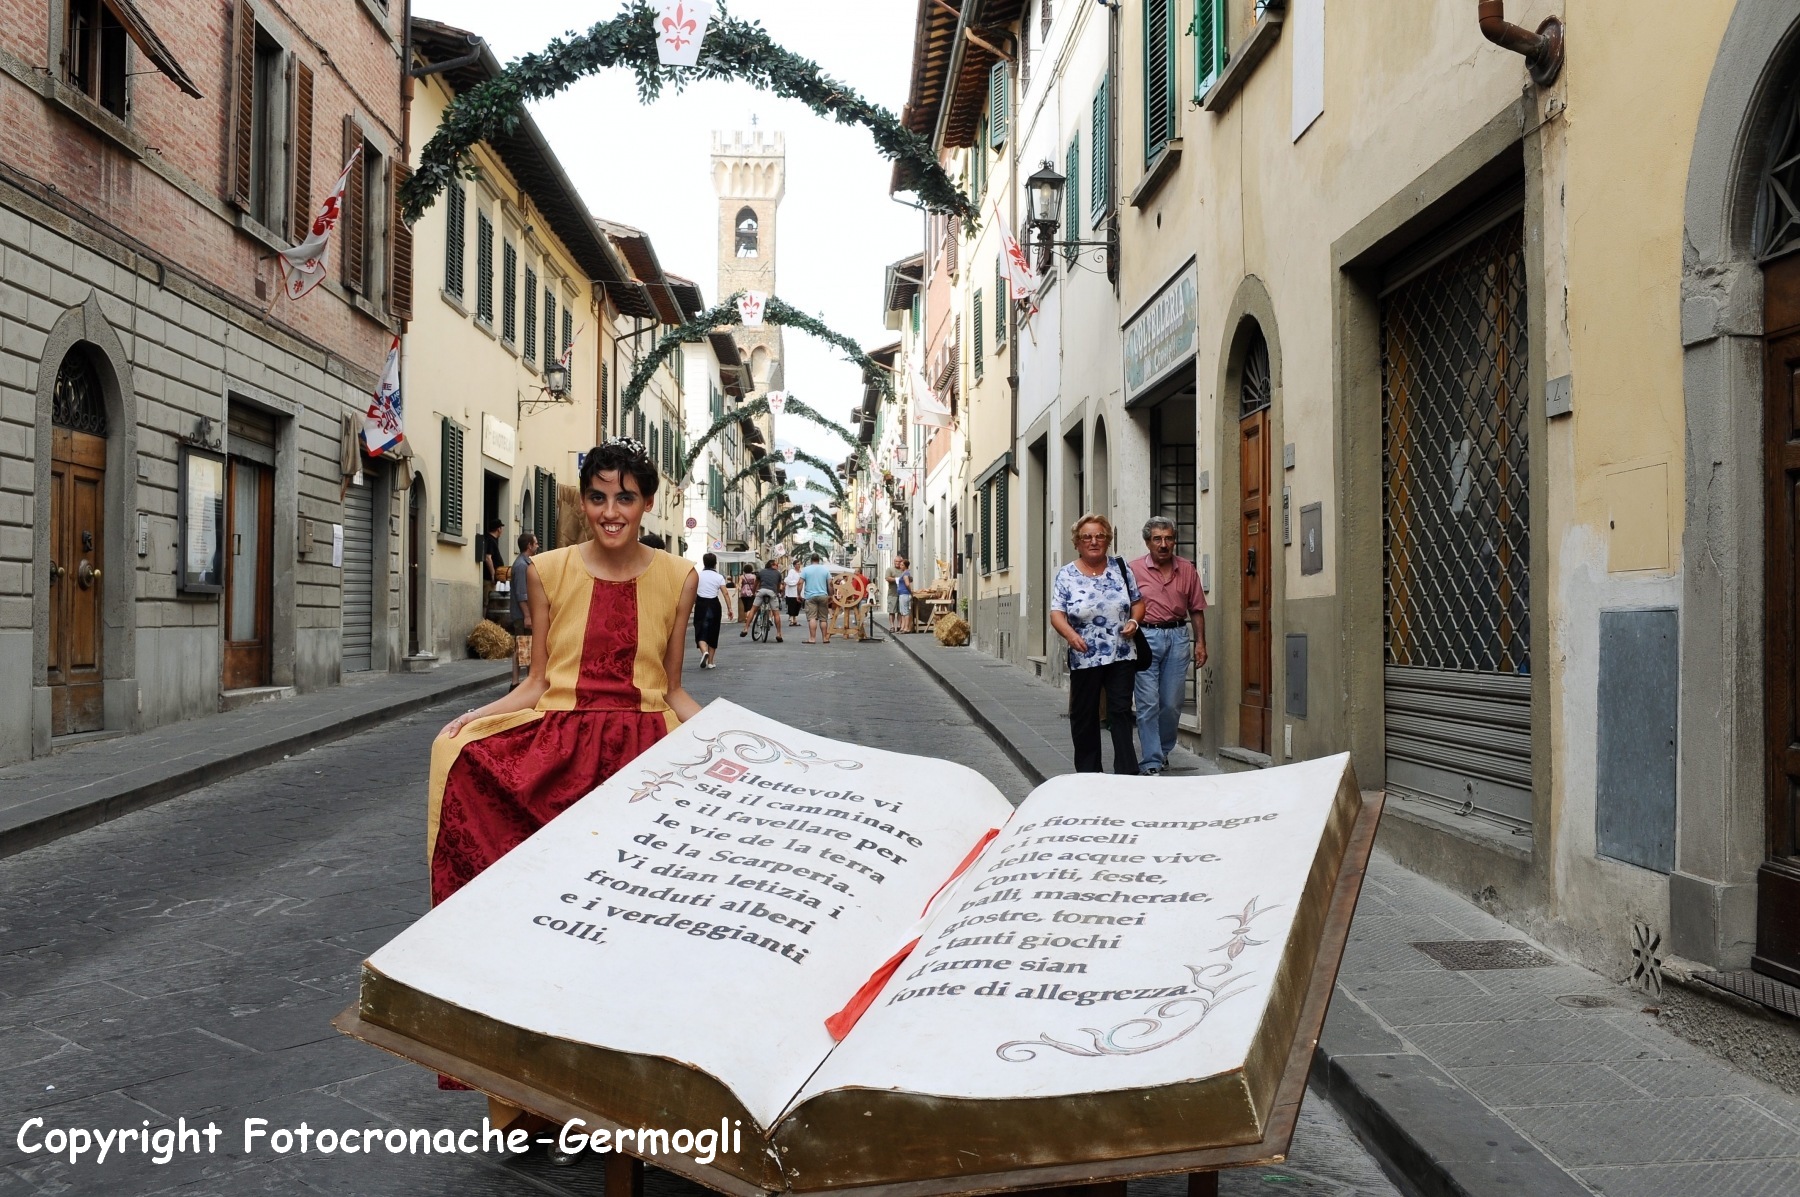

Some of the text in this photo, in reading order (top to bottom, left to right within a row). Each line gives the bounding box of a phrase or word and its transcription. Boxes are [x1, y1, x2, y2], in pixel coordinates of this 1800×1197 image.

[1133, 283, 1185, 357] COLTELLERIA
[705, 758, 903, 814] Dilettevole vi
[694, 783, 923, 849] sia il camminare
[1014, 813, 1278, 836] le fiorite campagne
[675, 800, 908, 866] e il favellare per
[1001, 833, 1138, 853] e i ruscelli
[652, 813, 885, 884] le vie de la terra
[988, 851, 1053, 872] delle
[1057, 852, 1147, 866] acque
[633, 833, 855, 898] de la Scarperia.
[974, 868, 1168, 892] Conviti, feste,
[618, 849, 845, 919] Vi dian letizia i
[583, 870, 816, 935] fronduti alberi
[958, 888, 1021, 913] balli,
[533, 916, 607, 945] colli,
[560, 893, 813, 965] e i verdeggianti
[1051, 910, 1146, 926] tornei
[925, 931, 1122, 957] e tanti giochi
[906, 957, 1087, 981] d'arme sian
[885, 981, 1197, 1007] fonte di allegrezza.
